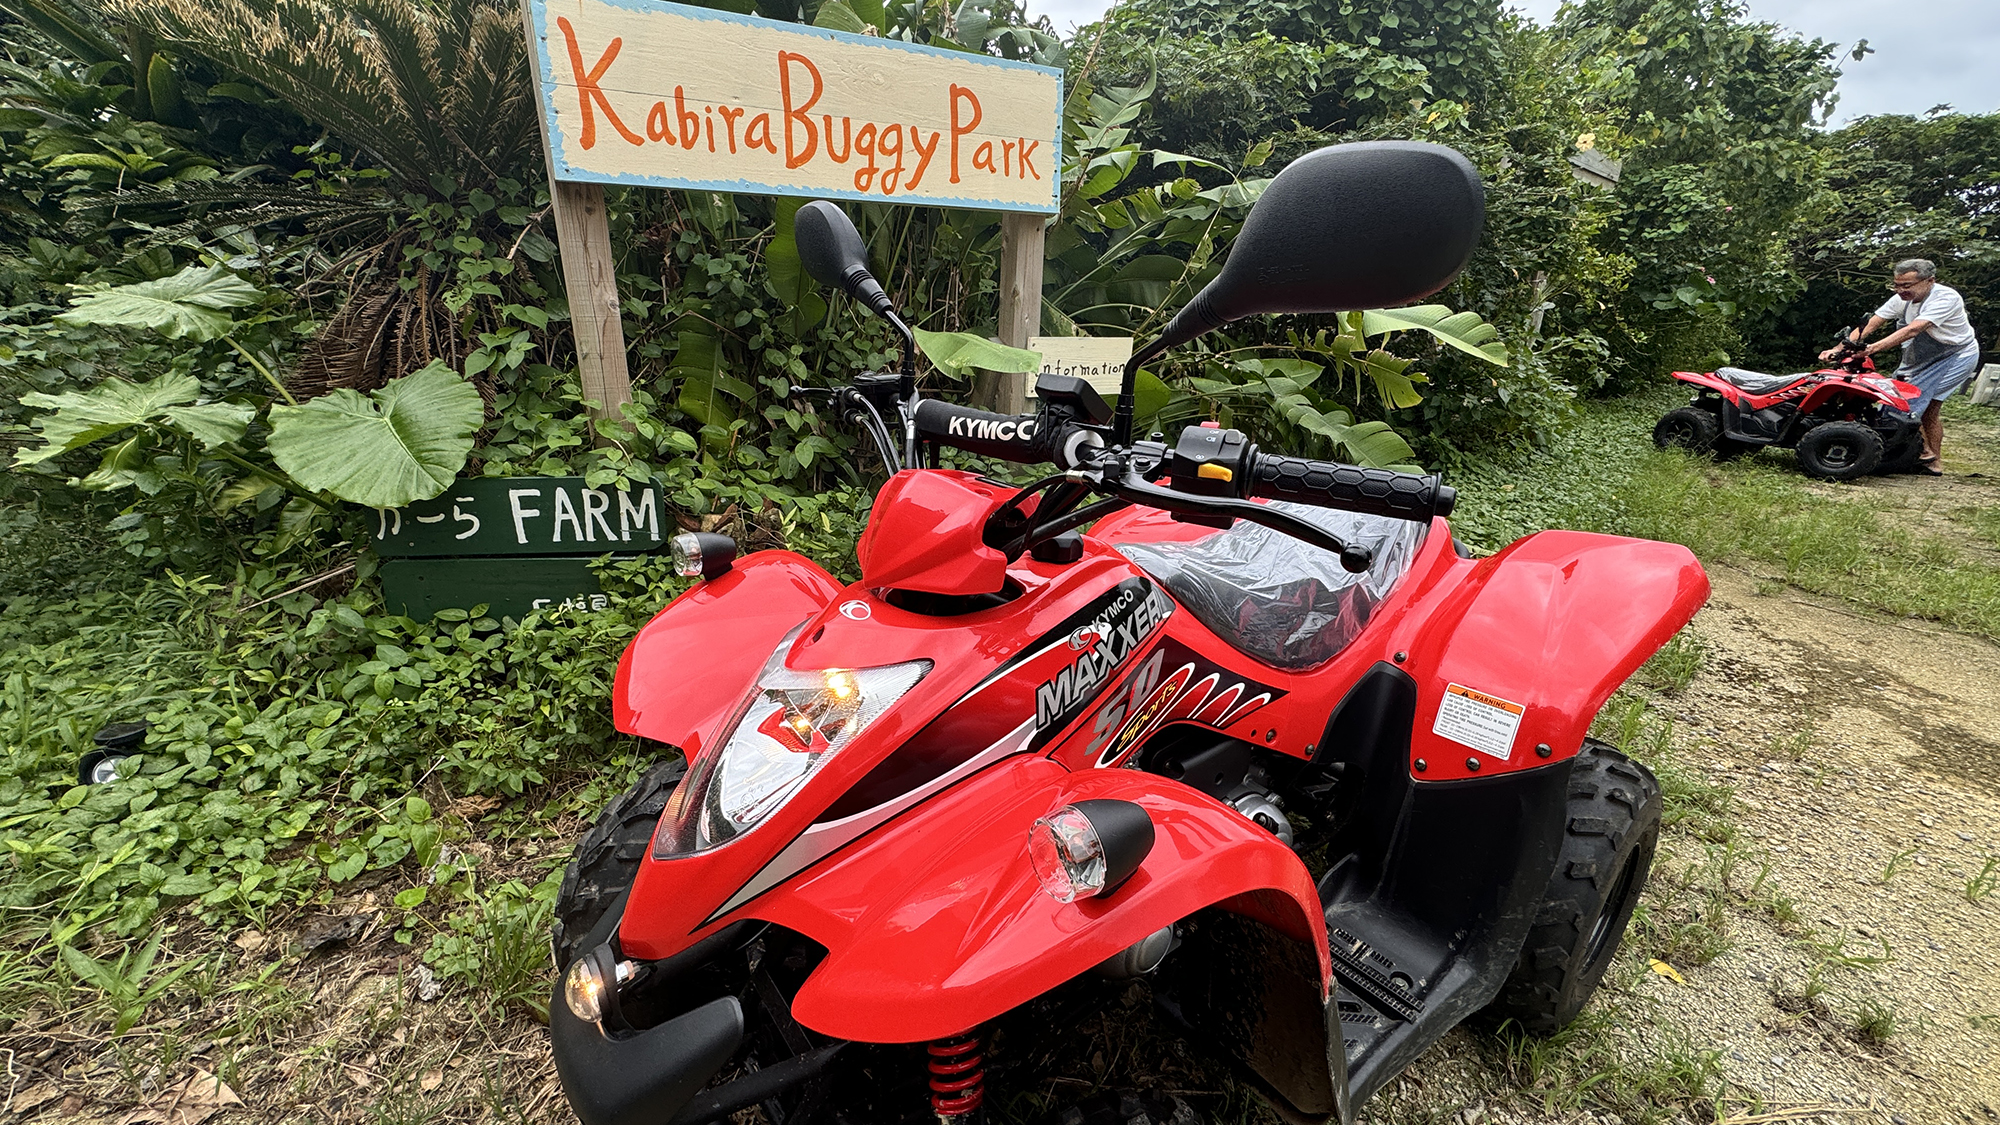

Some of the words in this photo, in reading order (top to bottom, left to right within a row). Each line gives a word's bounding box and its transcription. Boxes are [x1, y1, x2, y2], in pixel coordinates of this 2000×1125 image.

[557, 16, 777, 154] Kabira
[778, 50, 941, 195] Buggy
[949, 83, 1042, 184] Park
[1034, 359, 1126, 377] nformation
[949, 415, 1039, 441] KYMCO
[509, 487, 661, 544] FARM
[1092, 589, 1134, 632] KYMCO
[1036, 589, 1163, 731] MAXXER
[1084, 648, 1165, 756] 50
[1116, 680, 1178, 752] Sports
[1473, 693, 1507, 709] WARNING
